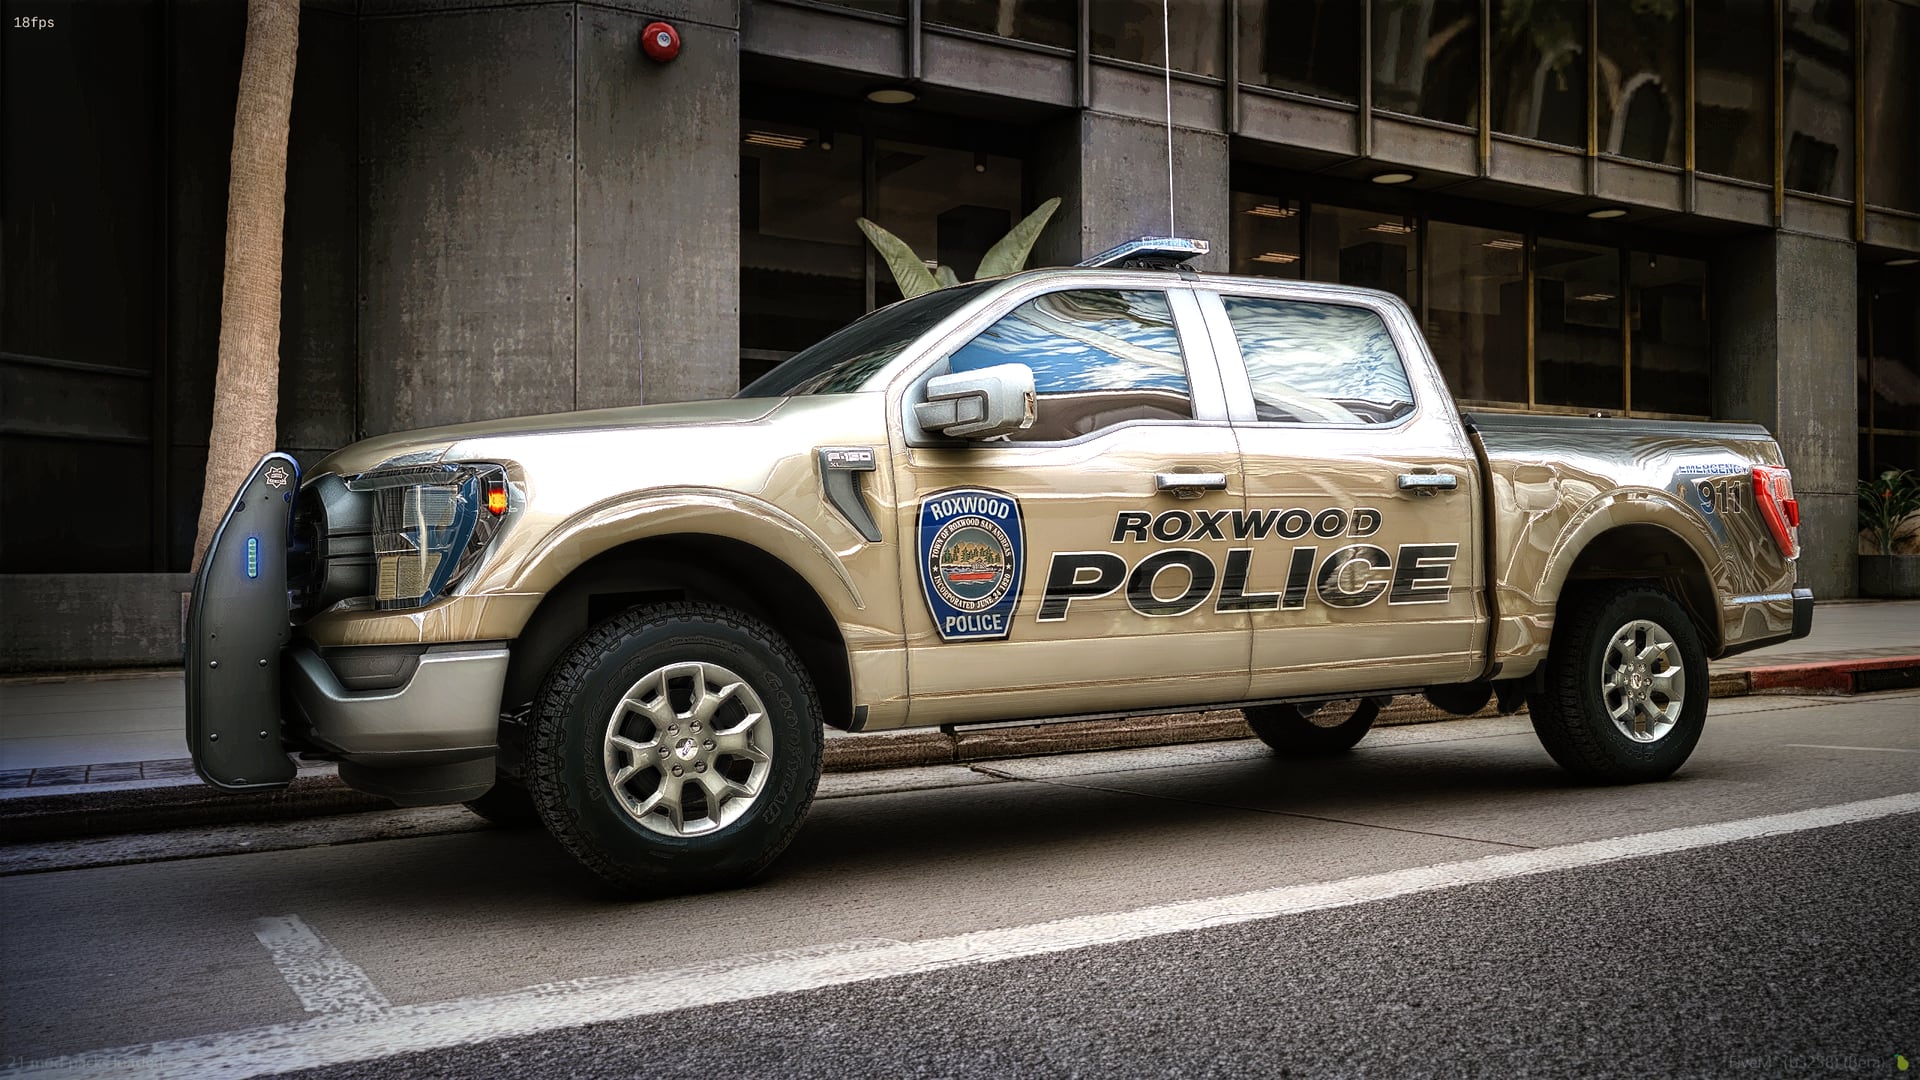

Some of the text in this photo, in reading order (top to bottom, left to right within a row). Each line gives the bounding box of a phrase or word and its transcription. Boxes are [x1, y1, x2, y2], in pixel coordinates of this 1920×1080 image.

[1678, 463, 1750, 475] EMERGENCY
[930, 496, 1010, 521] ROXWOOD
[1697, 479, 1742, 514] 911
[932, 518, 1012, 558] TOWN OF ROXWOOD SAN ANDREAS
[1111, 508, 1382, 543] ROXWOOD
[934, 575, 975, 609] INCORPORATED
[976, 597, 994, 609] JUNE
[1000, 573, 1011, 591] 1820
[1036, 543, 1459, 623] POLICE
[945, 614, 1003, 633] POLICE
